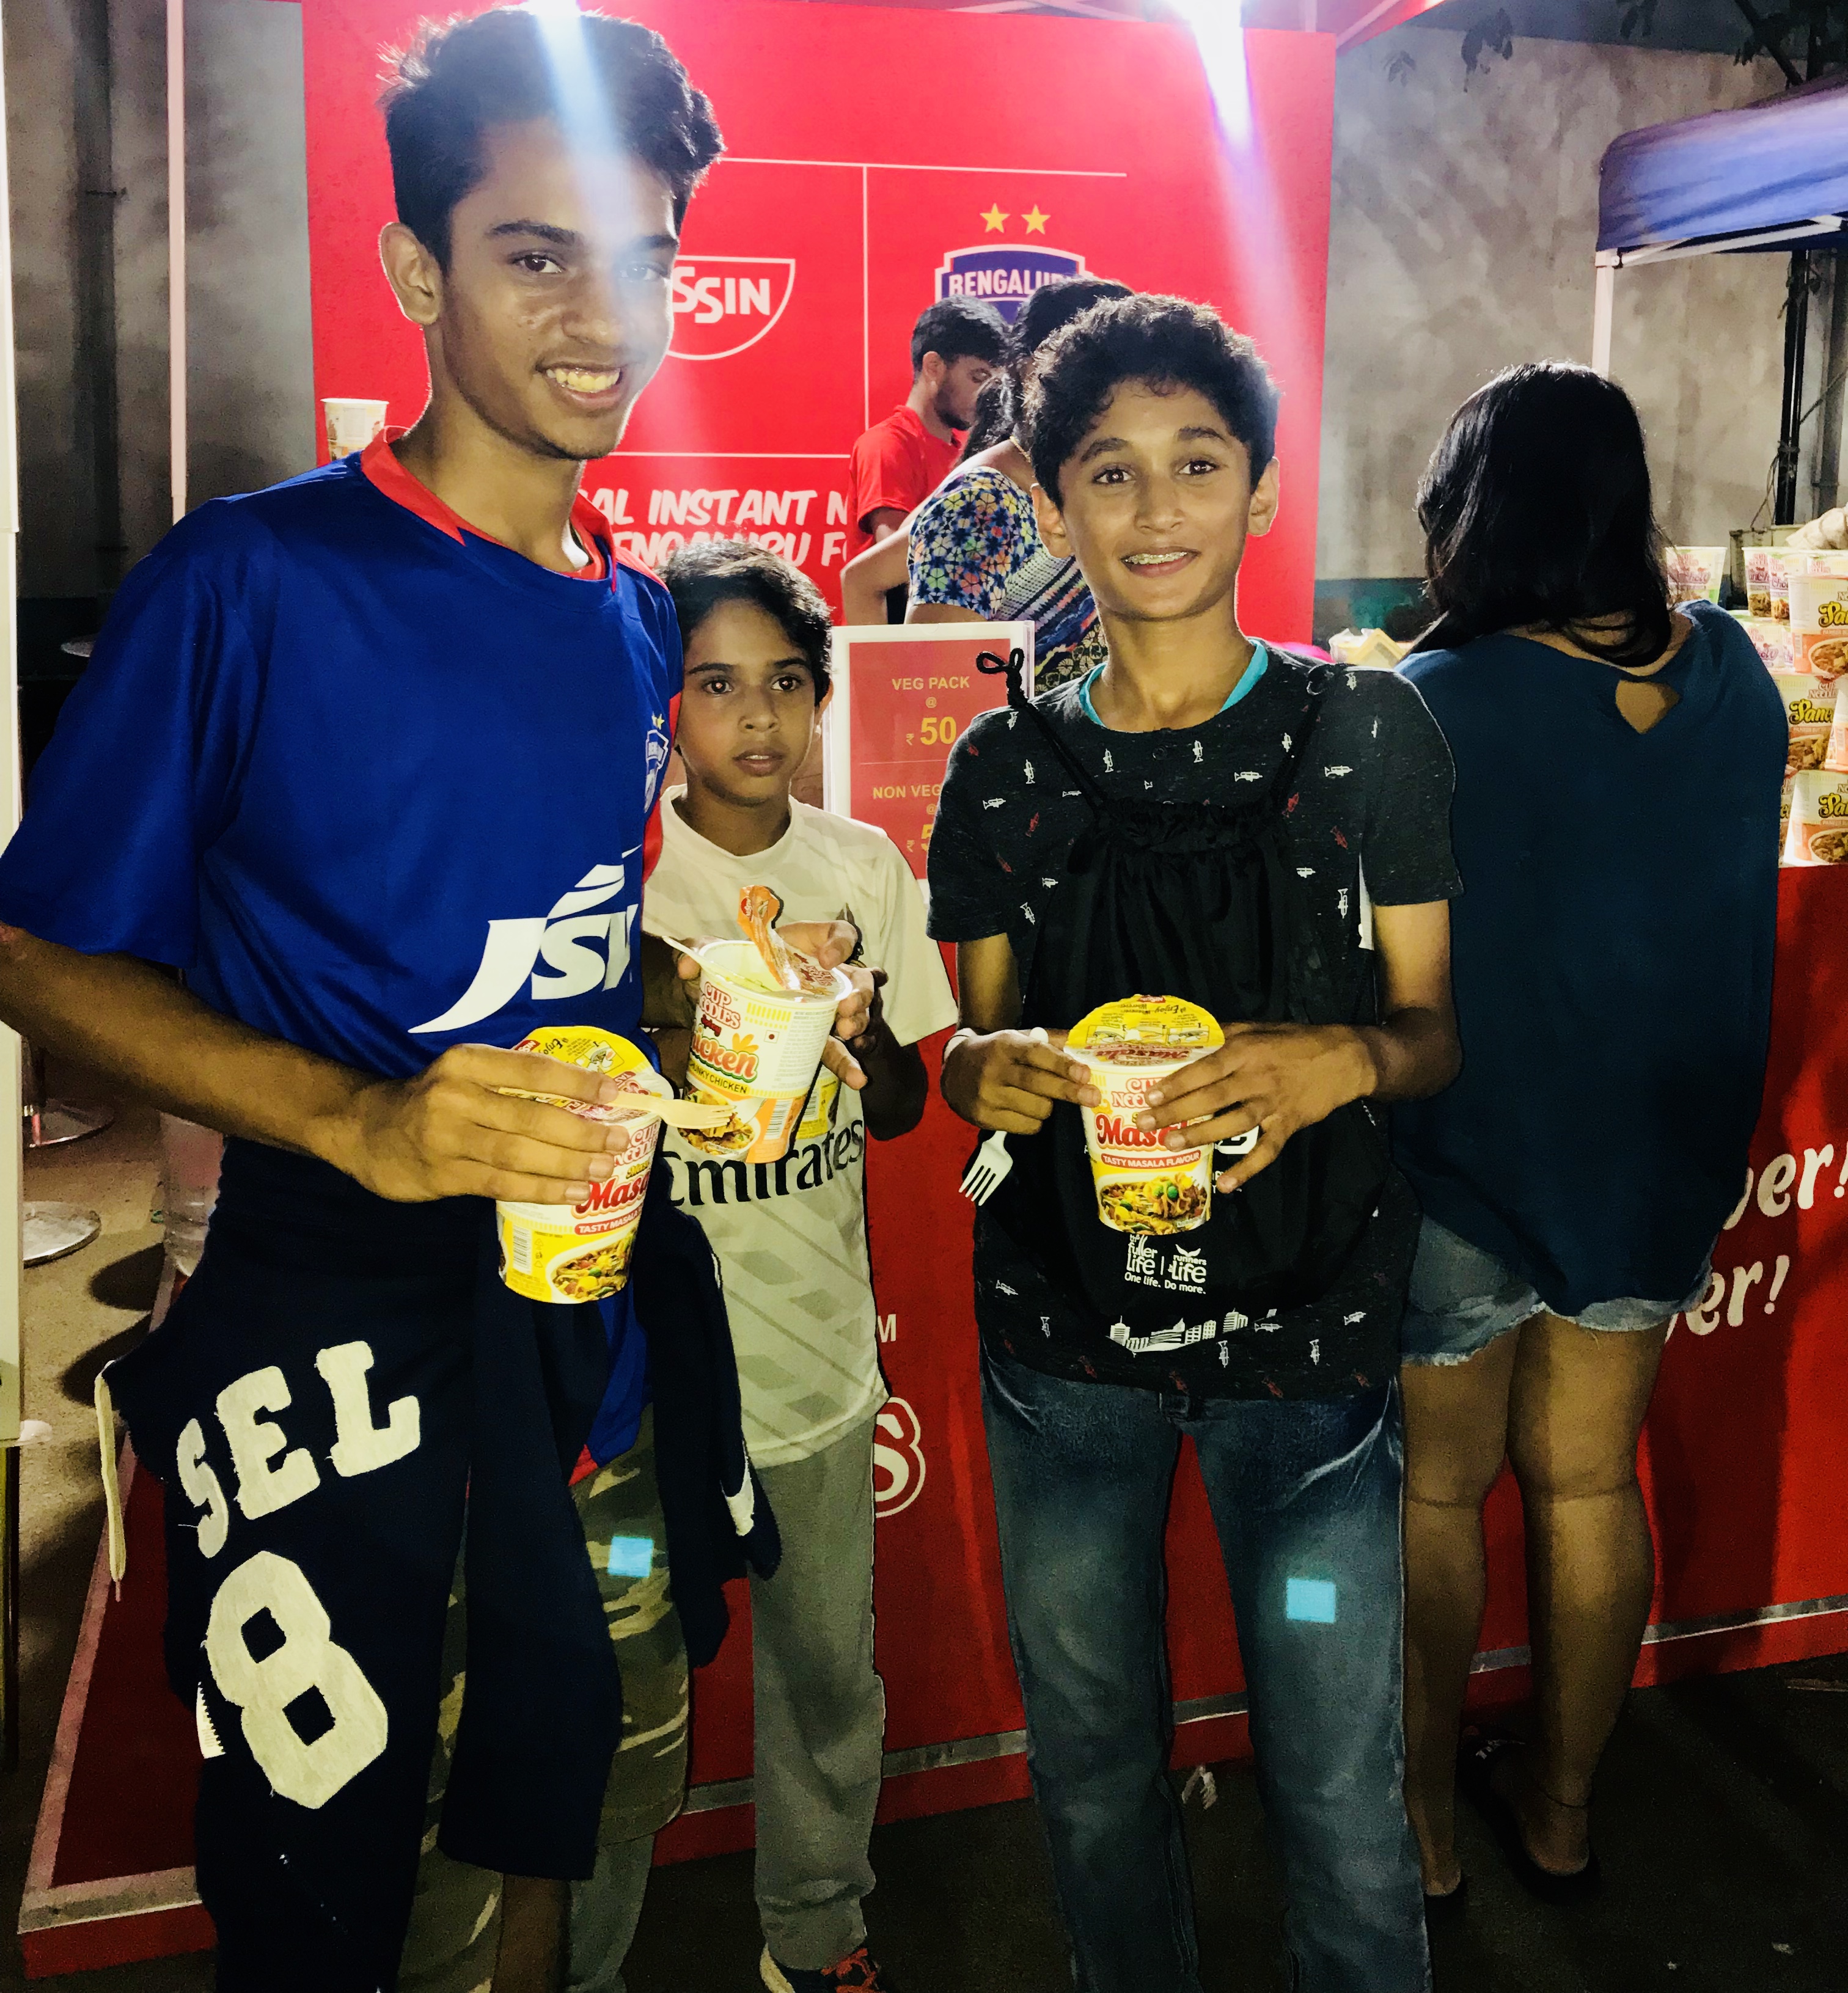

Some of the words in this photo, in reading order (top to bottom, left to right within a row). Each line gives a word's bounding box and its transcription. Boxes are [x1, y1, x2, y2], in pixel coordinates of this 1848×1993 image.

[578, 488, 634, 525] AL
[648, 489, 817, 525] INSTANT
[826, 491, 848, 525] N
[821, 532, 848, 566] F
[892, 678, 923, 690] VEG
[928, 676, 970, 690] PACK
[925, 697, 937, 708] @
[920, 716, 956, 745] 50
[873, 786, 905, 799] NON
[911, 784, 942, 797] VEG
[705, 982, 732, 1006] CUP
[710, 1074, 747, 1094] CHICKEN
[1103, 1155, 1126, 1166] TASTY
[1128, 1159, 1165, 1168] MASALA
[1166, 1152, 1200, 1166] FLAVOUR
[578, 1222, 609, 1234] TASTY
[1124, 1271, 1142, 1284] One
[1164, 1279, 1177, 1290] Do
[1179, 1284, 1206, 1295] more.
[177, 1341, 421, 1559] SEL
[205, 1550, 389, 1809] 8
